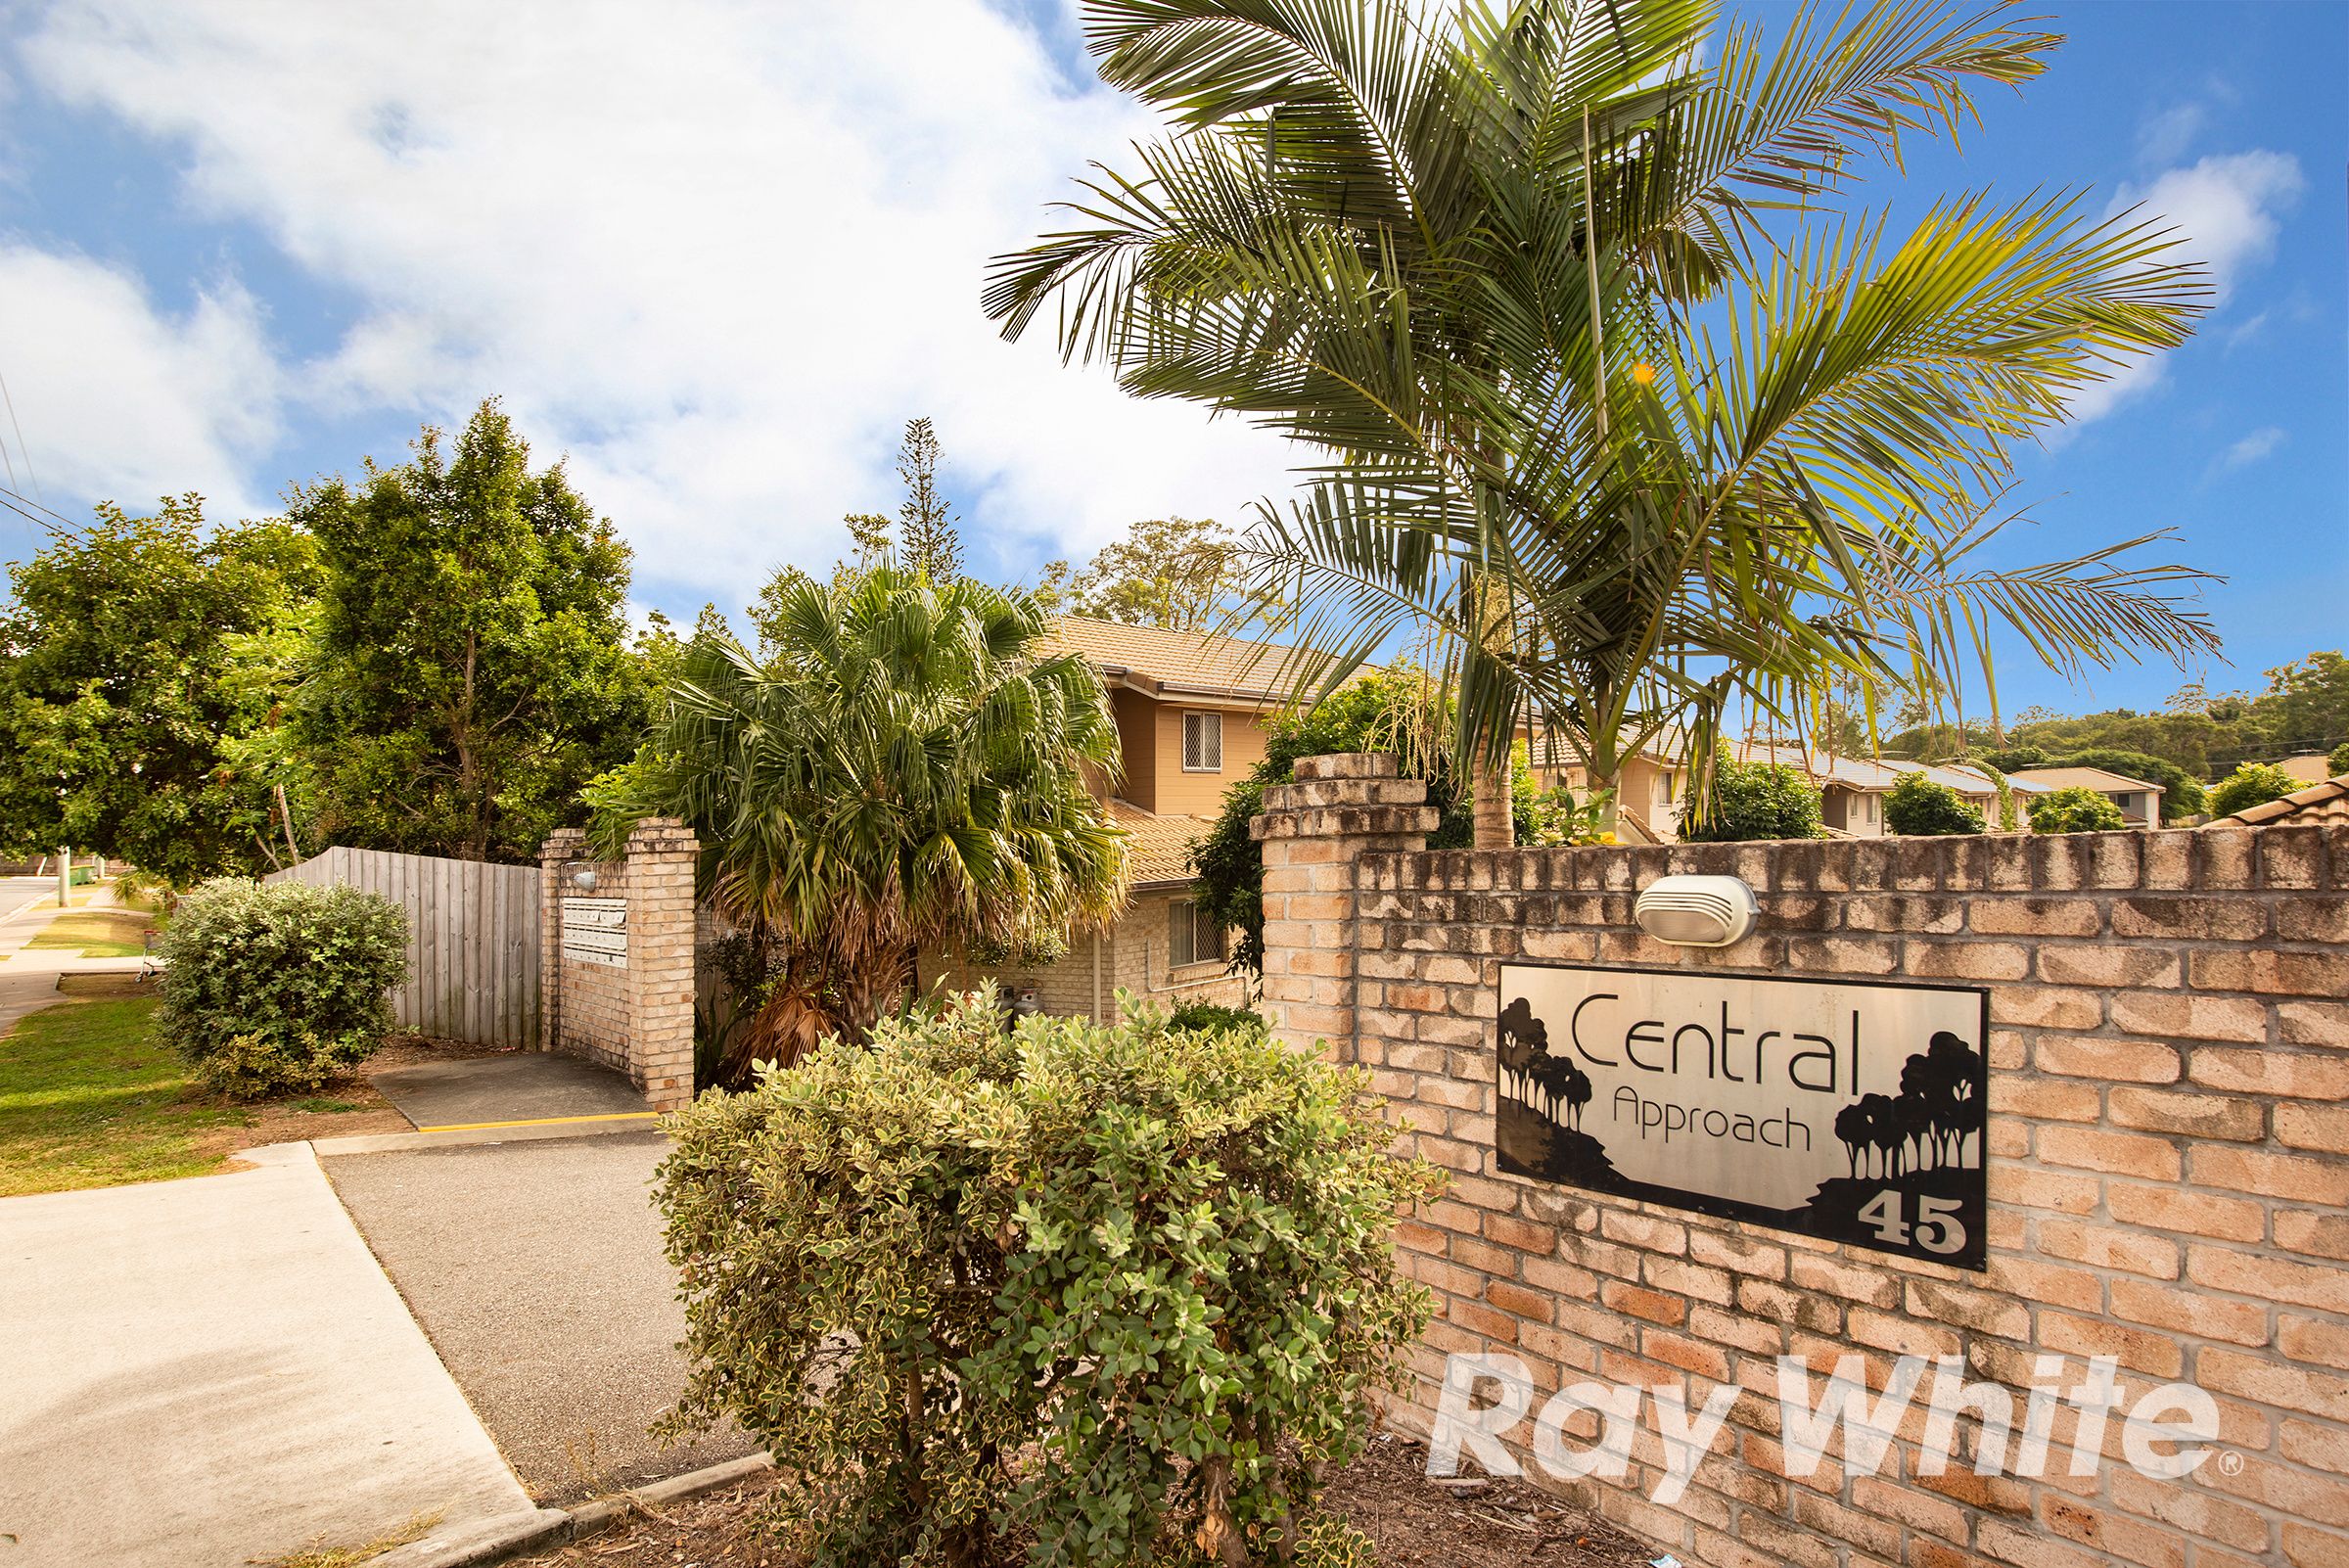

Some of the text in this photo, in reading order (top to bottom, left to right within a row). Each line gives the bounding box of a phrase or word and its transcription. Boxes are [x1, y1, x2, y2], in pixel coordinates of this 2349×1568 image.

[1572, 993, 1860, 1095] Central
[1613, 1085, 1811, 1151] Approach
[1858, 1188, 1967, 1254] 45
